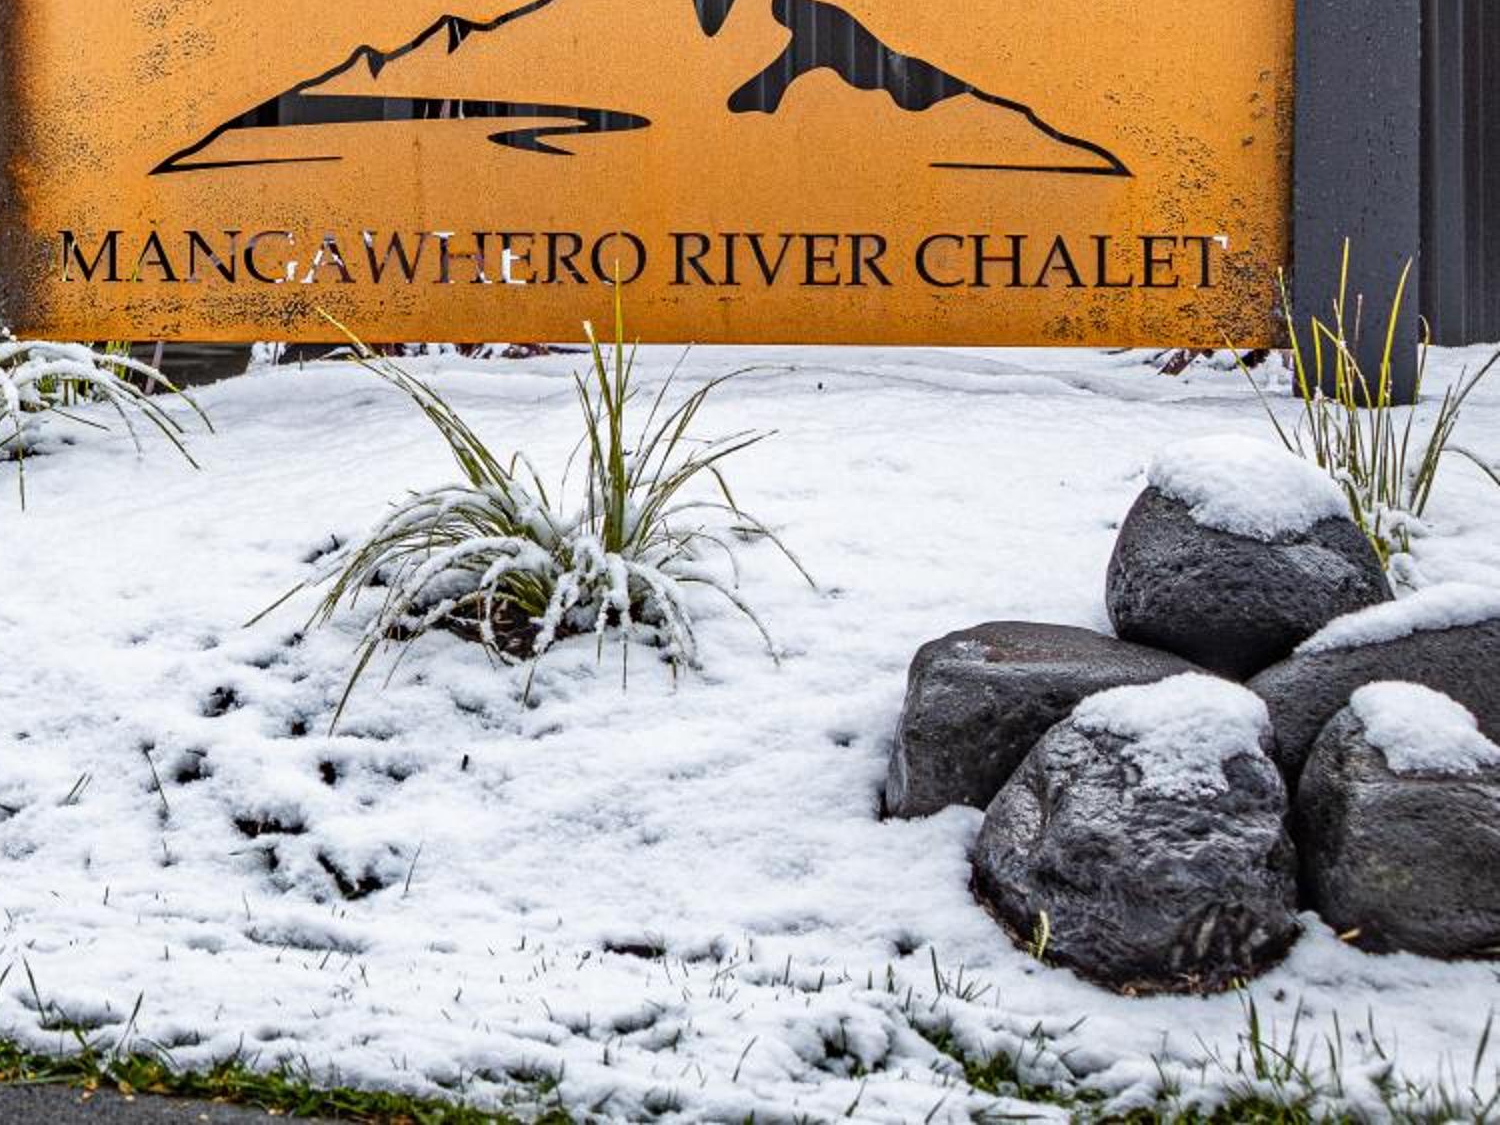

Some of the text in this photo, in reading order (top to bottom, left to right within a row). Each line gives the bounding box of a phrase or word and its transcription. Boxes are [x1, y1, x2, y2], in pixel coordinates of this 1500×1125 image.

[58, 229, 1227, 287] MANGAWHERO RIVER CHALET
